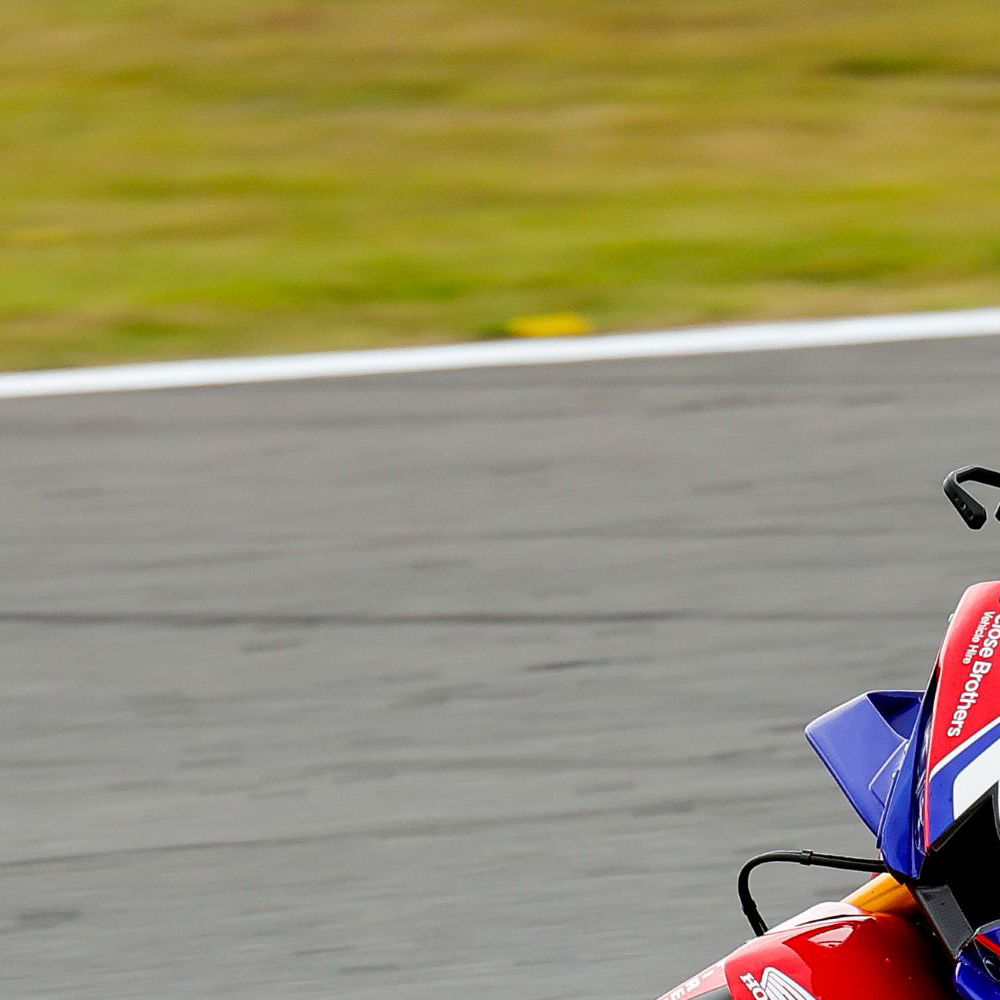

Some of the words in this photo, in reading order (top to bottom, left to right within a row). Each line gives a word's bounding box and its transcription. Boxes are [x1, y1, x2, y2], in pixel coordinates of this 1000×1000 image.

[972, 611, 995, 643] Vehicle
[962, 644, 979, 665] Hire
[947, 660, 992, 738] Brothers
